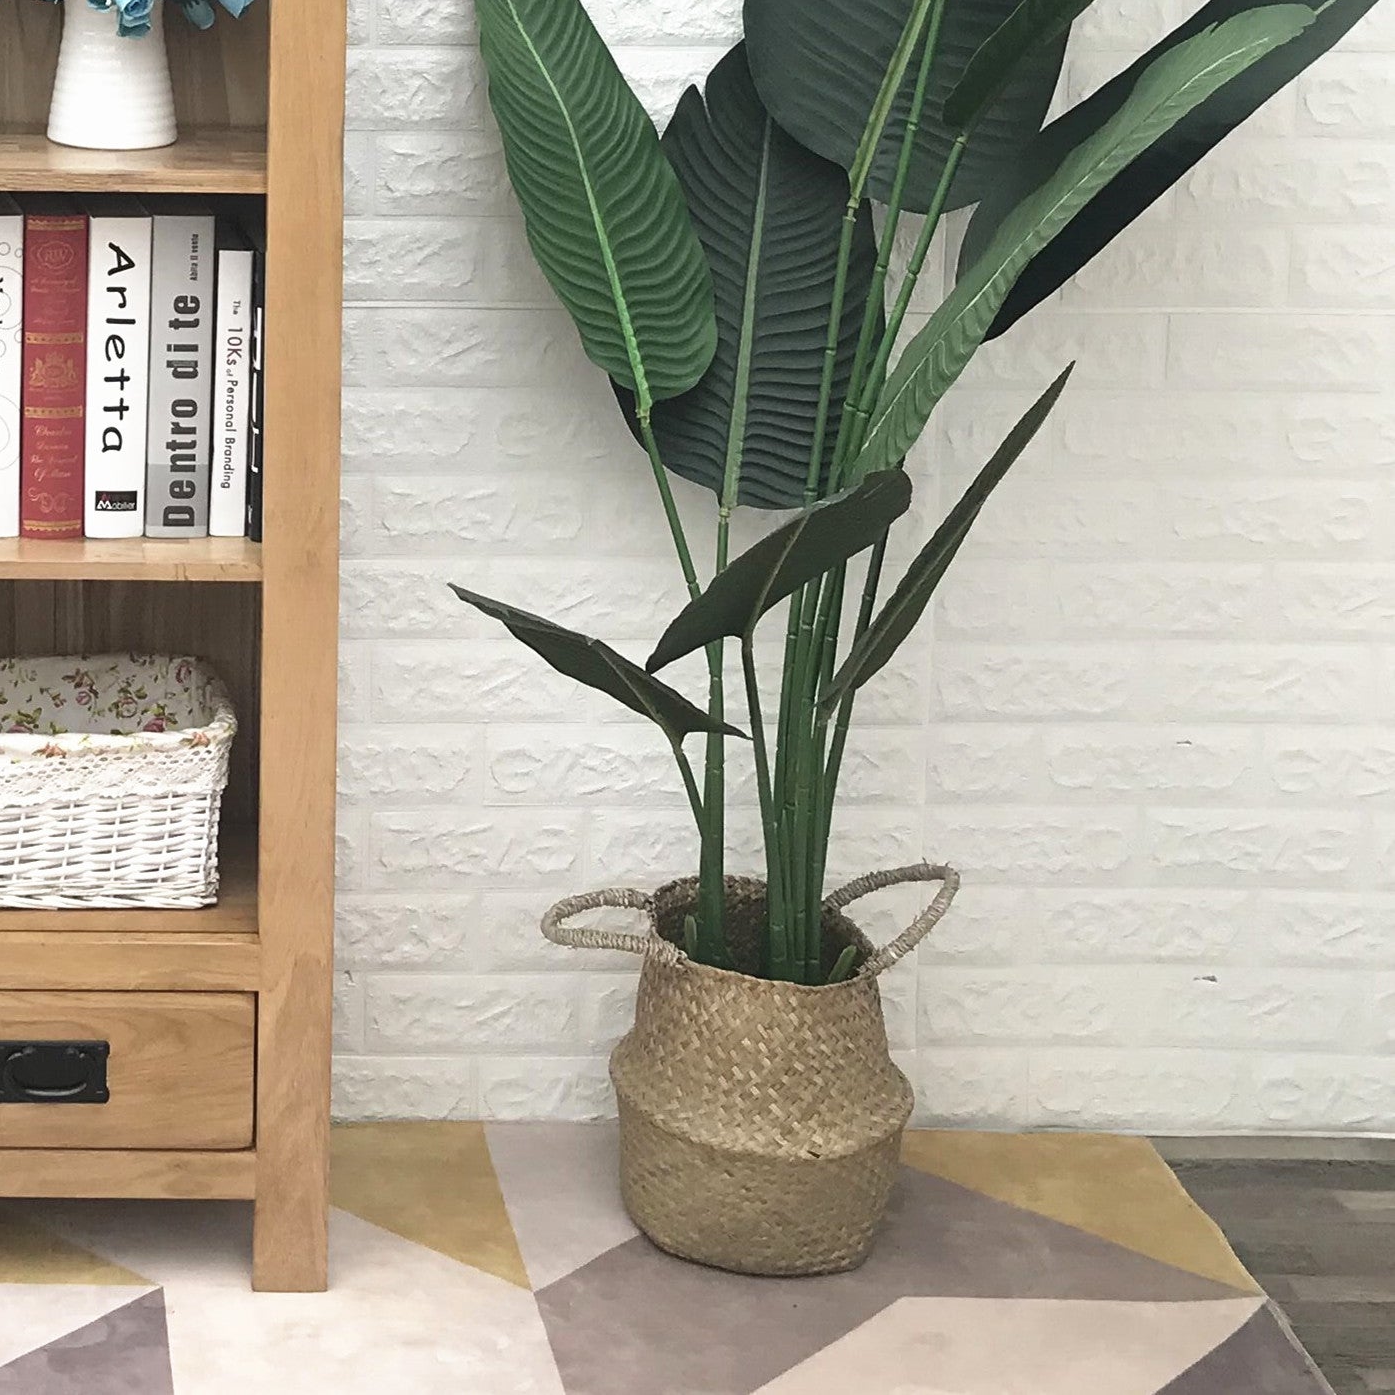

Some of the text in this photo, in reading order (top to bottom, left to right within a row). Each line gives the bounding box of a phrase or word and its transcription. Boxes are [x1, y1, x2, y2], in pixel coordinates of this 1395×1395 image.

[232, 300, 241, 315] The
[101, 241, 136, 453] Arletta
[226, 326, 243, 366] 10Ks
[162, 295, 201, 528] Dentro di te
[224, 379, 238, 432] Personal
[220, 437, 236, 490] Branding
